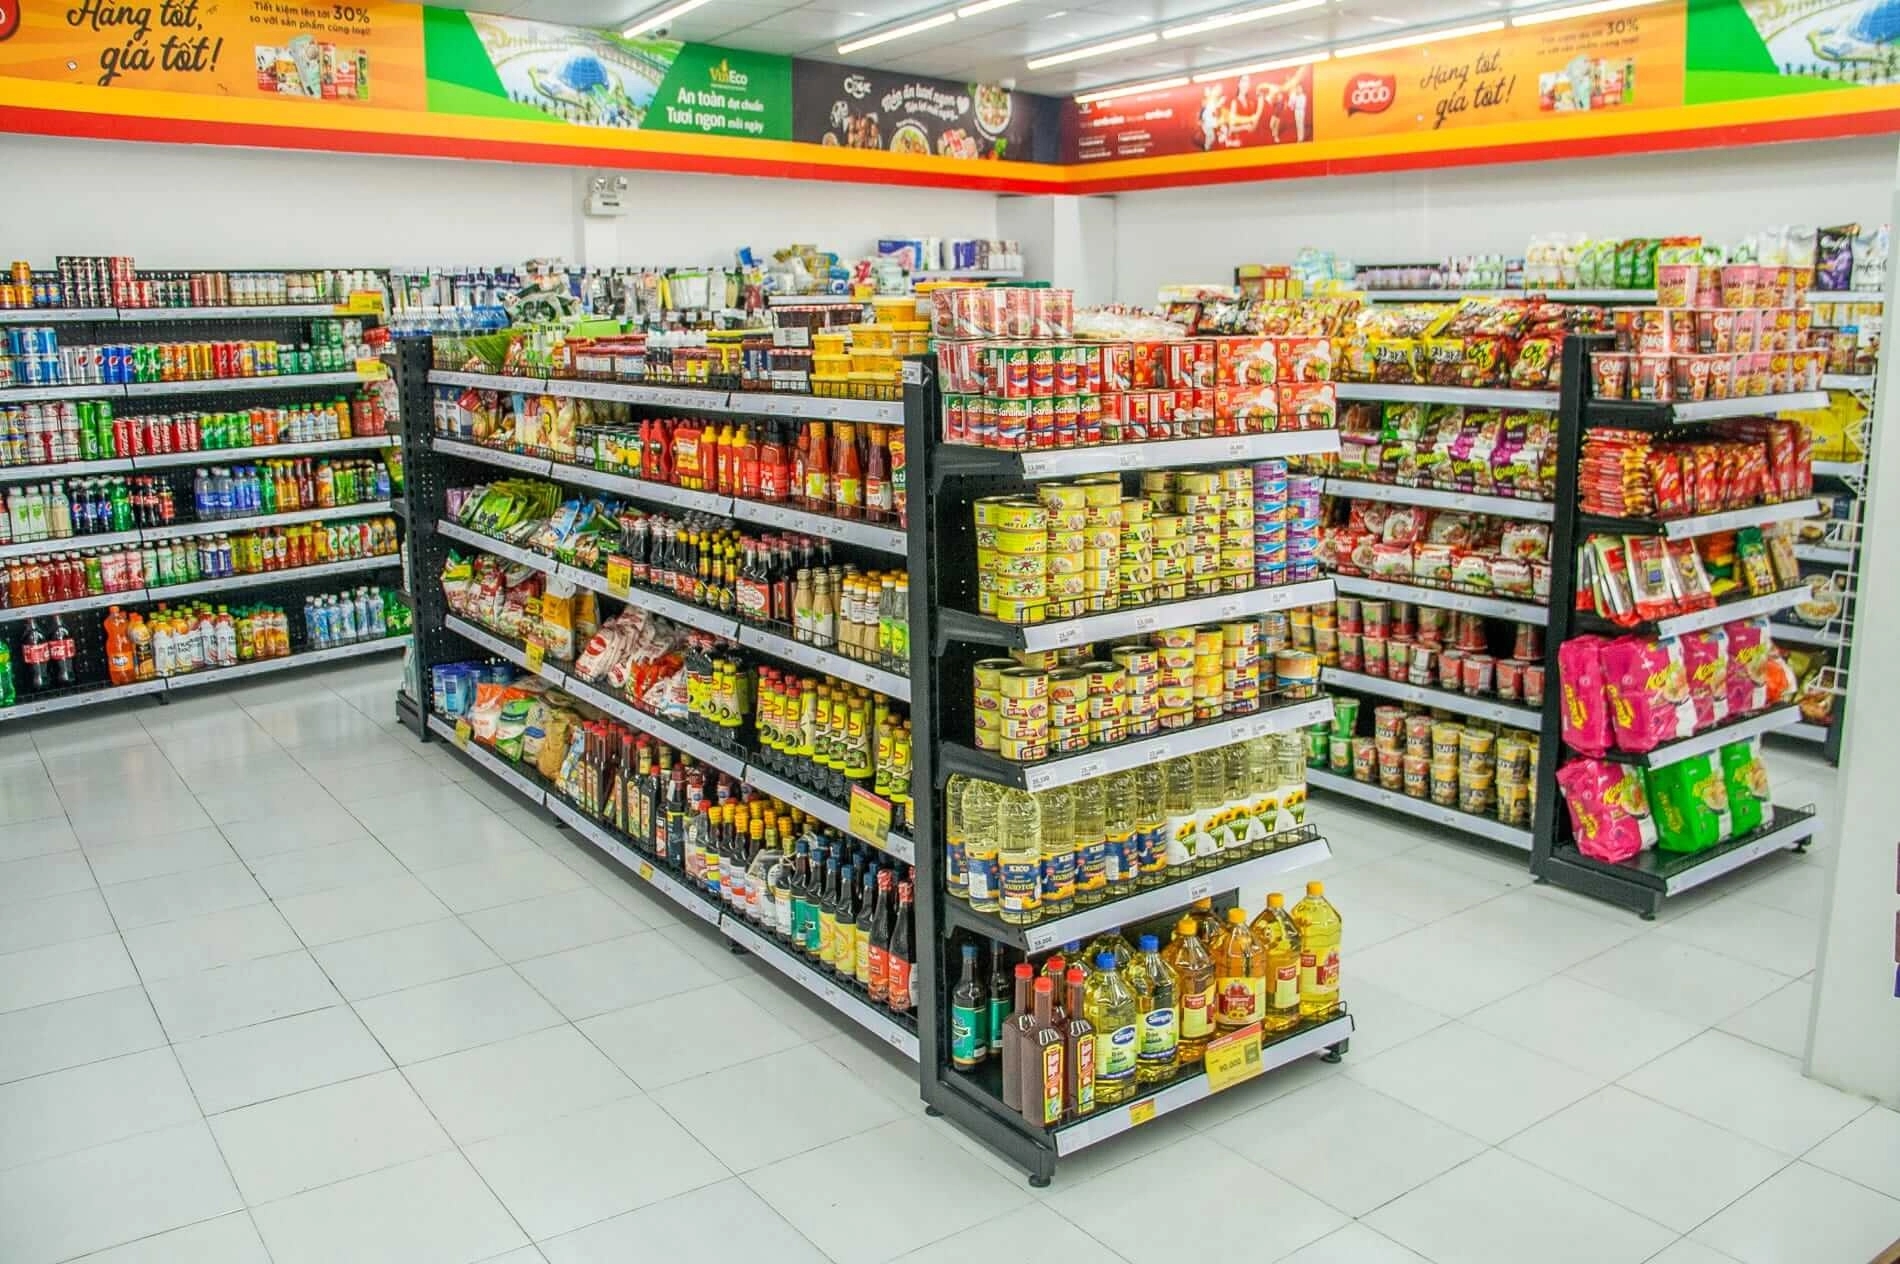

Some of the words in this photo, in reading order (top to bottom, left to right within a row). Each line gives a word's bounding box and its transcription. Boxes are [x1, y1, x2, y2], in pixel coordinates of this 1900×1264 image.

[67, 0, 152, 41] Hàng
[249, 15, 261, 23] so
[263, 16, 279, 25] với
[333, 4, 370, 24] 30%
[98, 40, 154, 86] giá
[161, 35, 224, 72] tốt!
[709, 66, 748, 85] VinEco
[678, 87, 696, 105] An
[697, 91, 726, 108] toàn
[1352, 87, 1391, 105] GOOD
[666, 106, 693, 125] Tươi
[695, 112, 726, 131] ngon
[1433, 90, 1469, 130] giá
